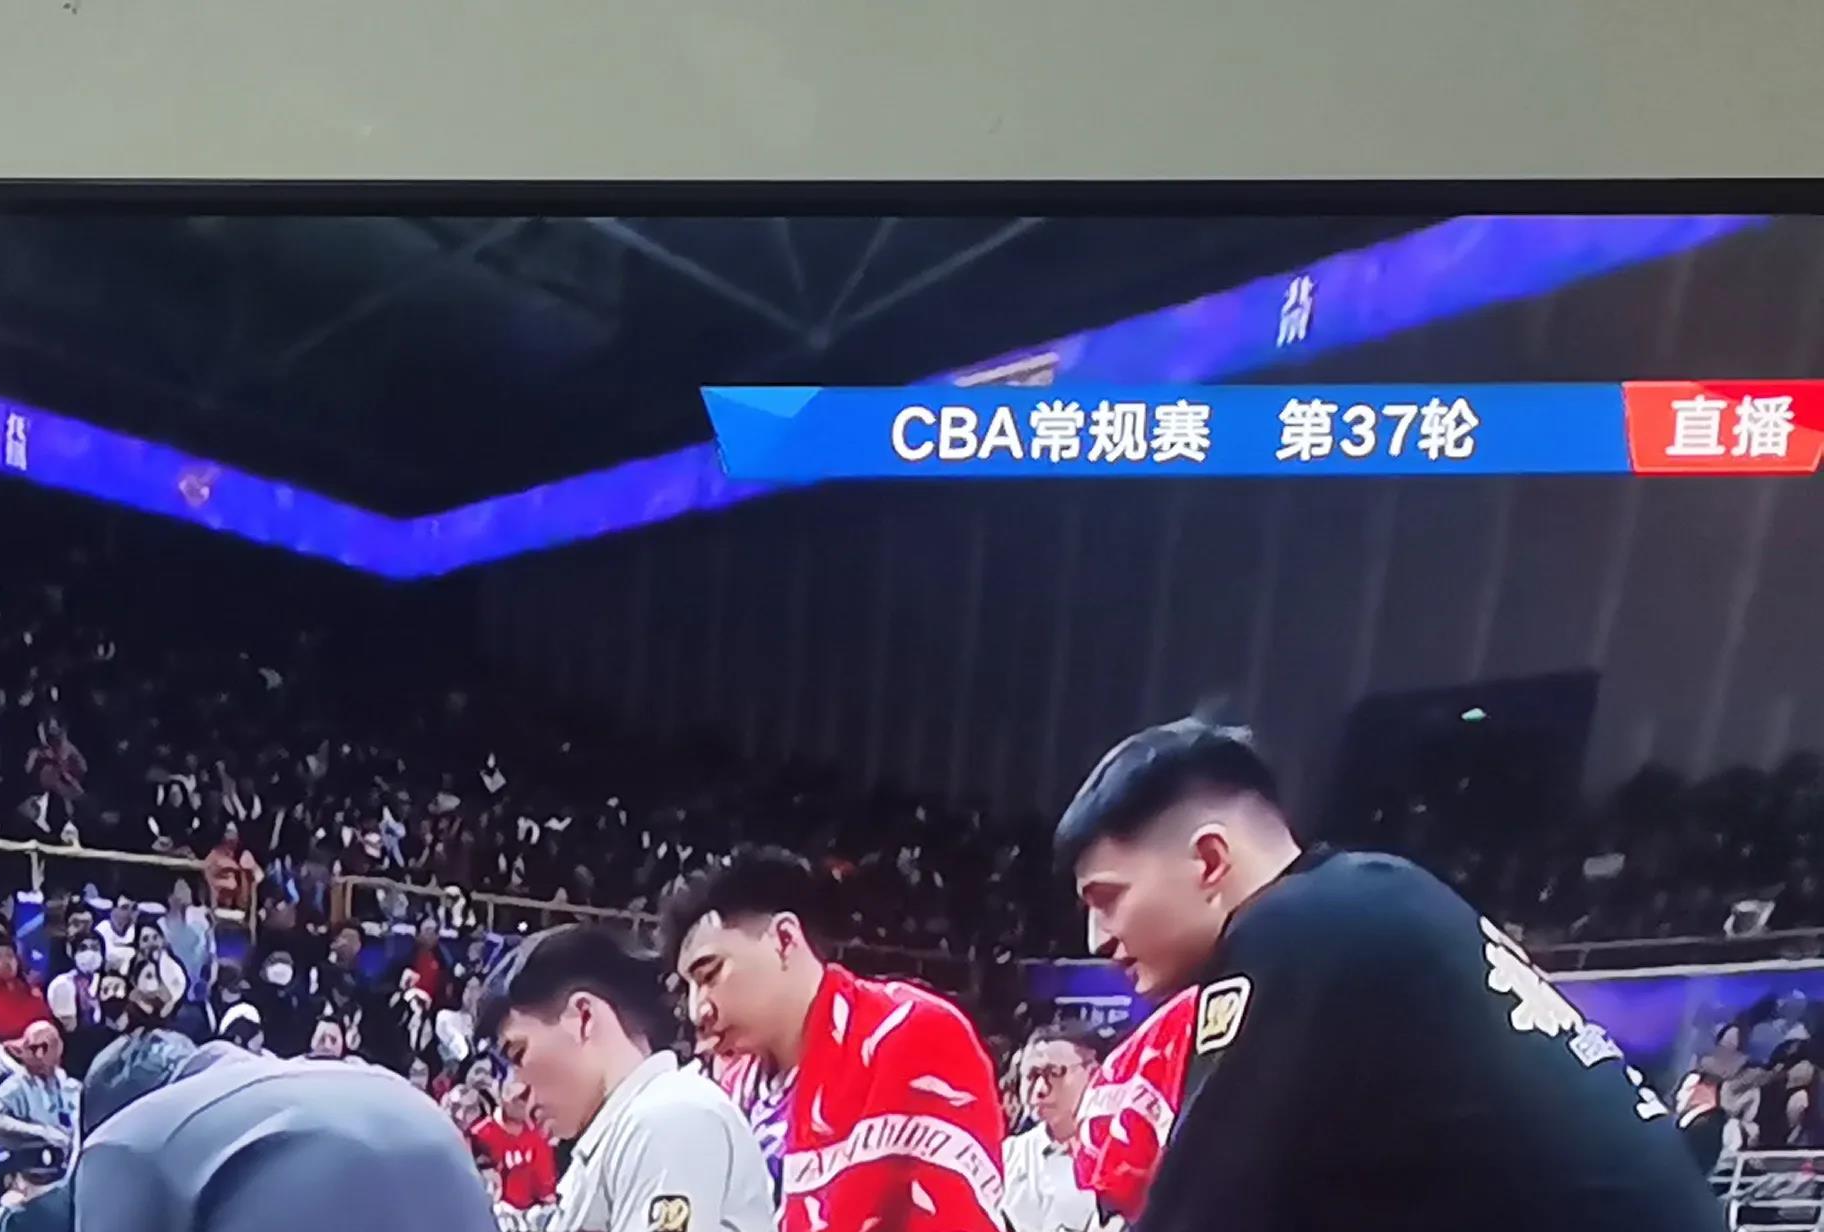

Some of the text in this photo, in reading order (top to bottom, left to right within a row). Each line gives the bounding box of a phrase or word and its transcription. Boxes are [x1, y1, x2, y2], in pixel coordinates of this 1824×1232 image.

[891, 398, 1479, 463] CBA常规赛 第37轮
[1665, 395, 1795, 458] 直播
